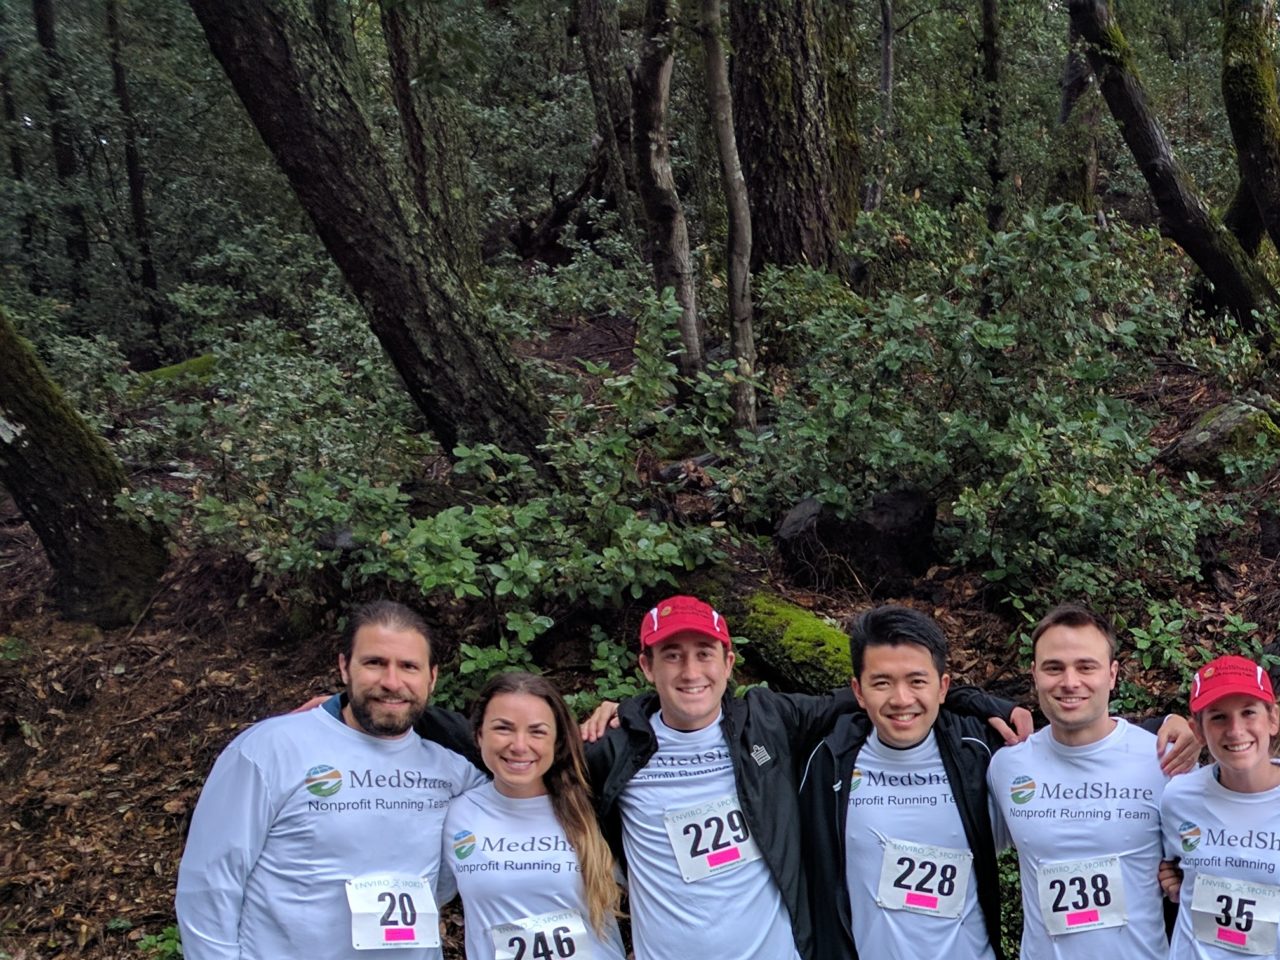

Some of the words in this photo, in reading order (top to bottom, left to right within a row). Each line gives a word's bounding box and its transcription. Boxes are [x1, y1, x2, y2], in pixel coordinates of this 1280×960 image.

[848, 795, 884, 808] nprofit
[887, 794, 938, 807] Running
[1040, 782, 1154, 801] MedShare
[308, 799, 372, 813] Nonprofit
[375, 798, 424, 812] Running
[1009, 807, 1056, 820] Nonprofit
[1059, 807, 1112, 821] Running
[1116, 807, 1151, 820] Team
[682, 809, 750, 859] 229
[503, 859, 561, 874] Running
[1224, 856, 1276, 874] Running
[892, 856, 958, 897] 228
[1048, 872, 1112, 913] 238
[377, 891, 417, 927] 20
[1214, 893, 1257, 933] 35
